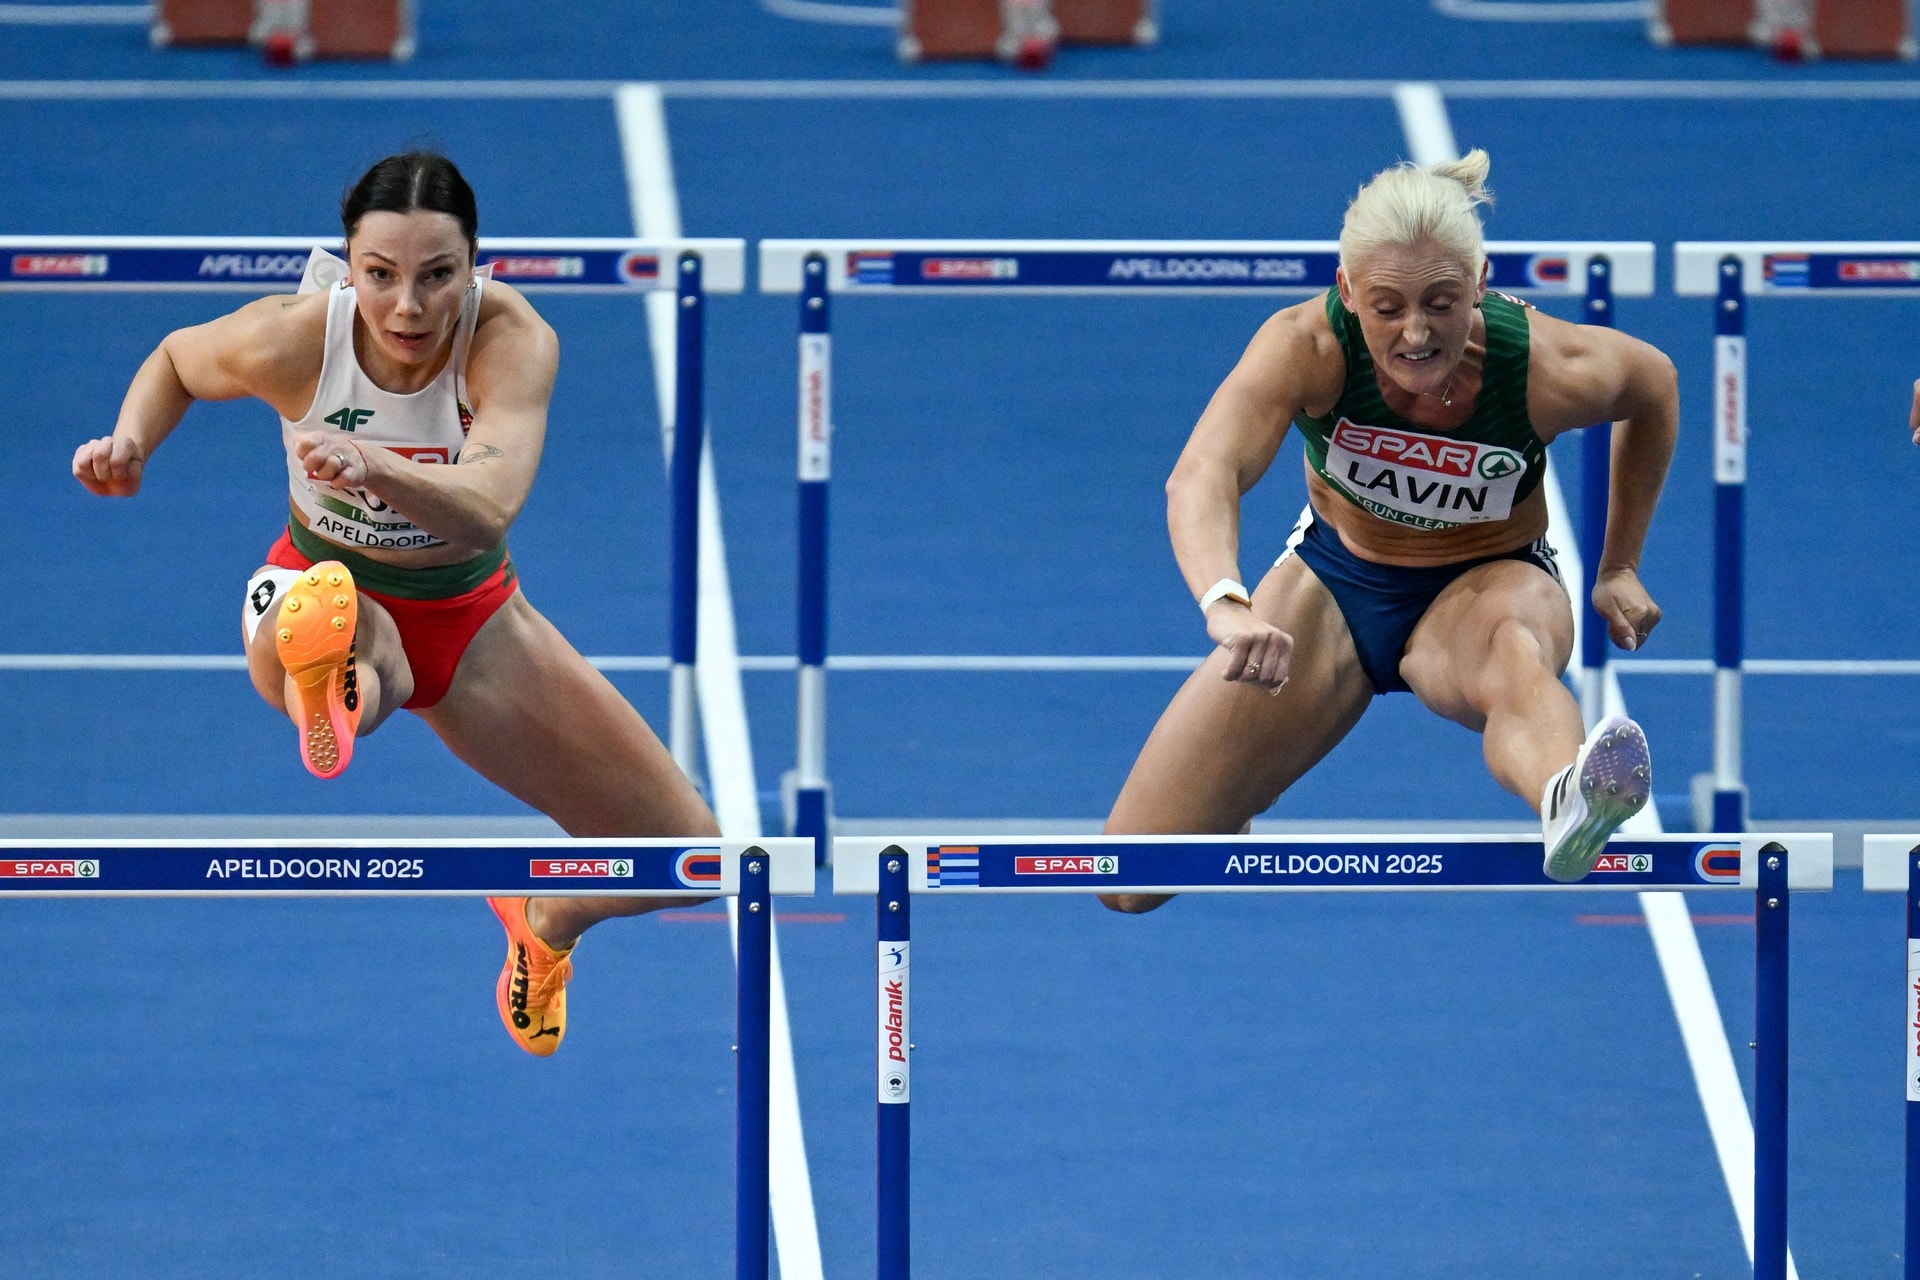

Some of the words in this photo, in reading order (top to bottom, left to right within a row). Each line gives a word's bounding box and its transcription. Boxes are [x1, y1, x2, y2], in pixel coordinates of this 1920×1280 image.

[199, 255, 308, 276] APELDOO
[1109, 258, 1248, 279] APELDOORN
[1253, 258, 1307, 280] 2025
[324, 407, 375, 432] 4F
[1340, 430, 1472, 472] SPAR
[1347, 461, 1489, 512] LAVIN
[1363, 499, 1399, 519] RUN
[15, 863, 74, 874] SPAR
[206, 859, 360, 878] APELDOORN
[367, 859, 424, 878] 2025
[549, 862, 608, 873] SPAR
[1034, 859, 1093, 870] SPAR
[1225, 855, 1379, 874] APELDOORN
[1386, 854, 1443, 874] 2025
[1597, 858, 1627, 868] AR
[885, 979, 906, 1062] polanik
